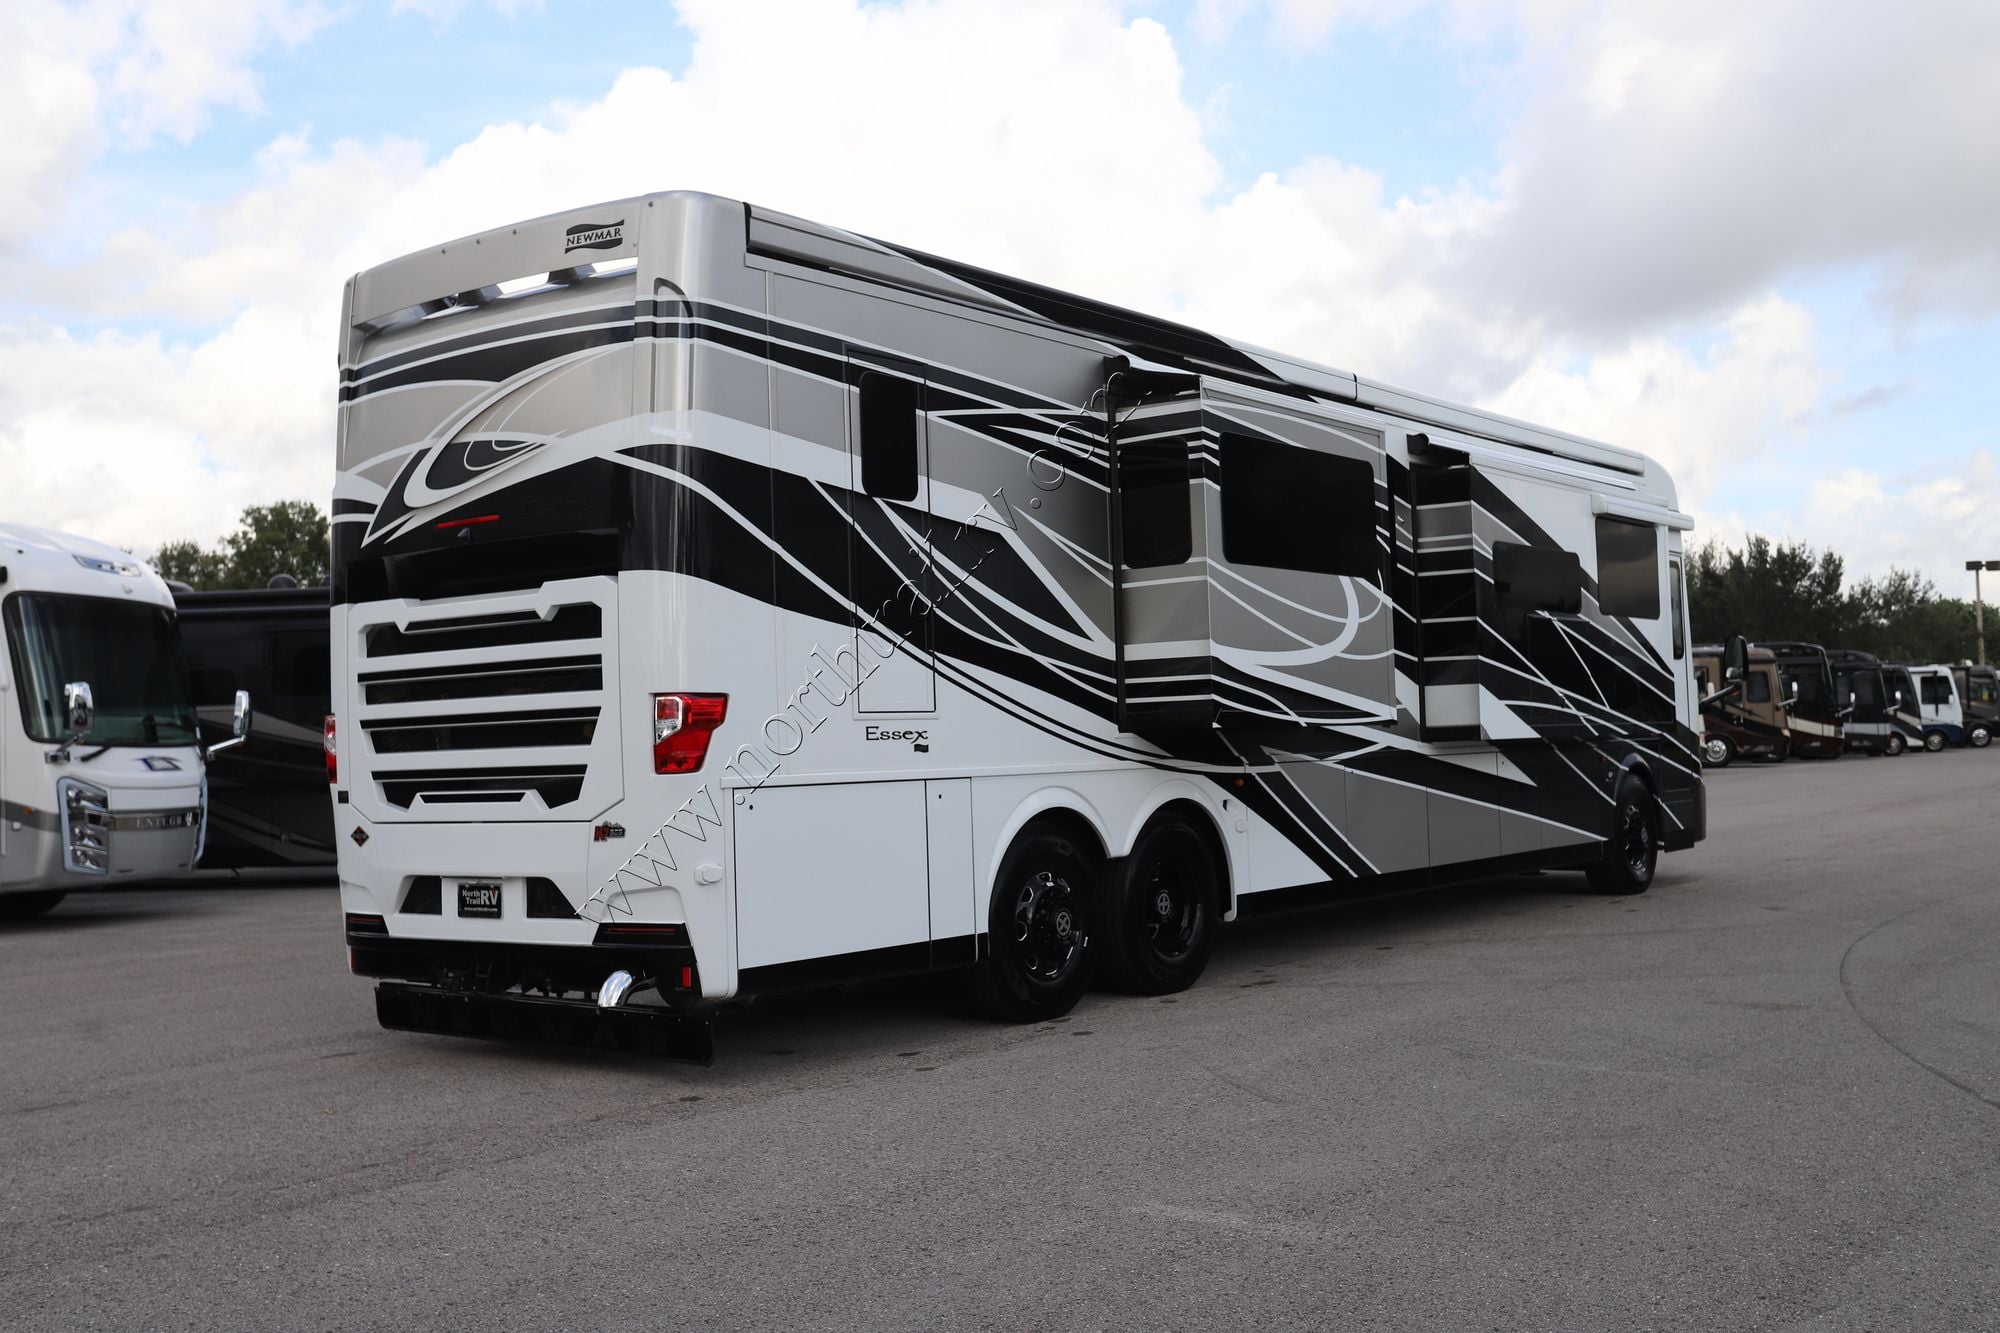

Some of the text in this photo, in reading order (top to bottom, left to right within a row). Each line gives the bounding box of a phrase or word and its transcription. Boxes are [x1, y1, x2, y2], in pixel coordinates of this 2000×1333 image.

[566, 227, 622, 247] NEWMAR
[865, 725, 929, 744] Essex
[462, 889, 480, 897] North
[465, 897, 480, 905] Trail
[480, 889, 499, 905] RV
